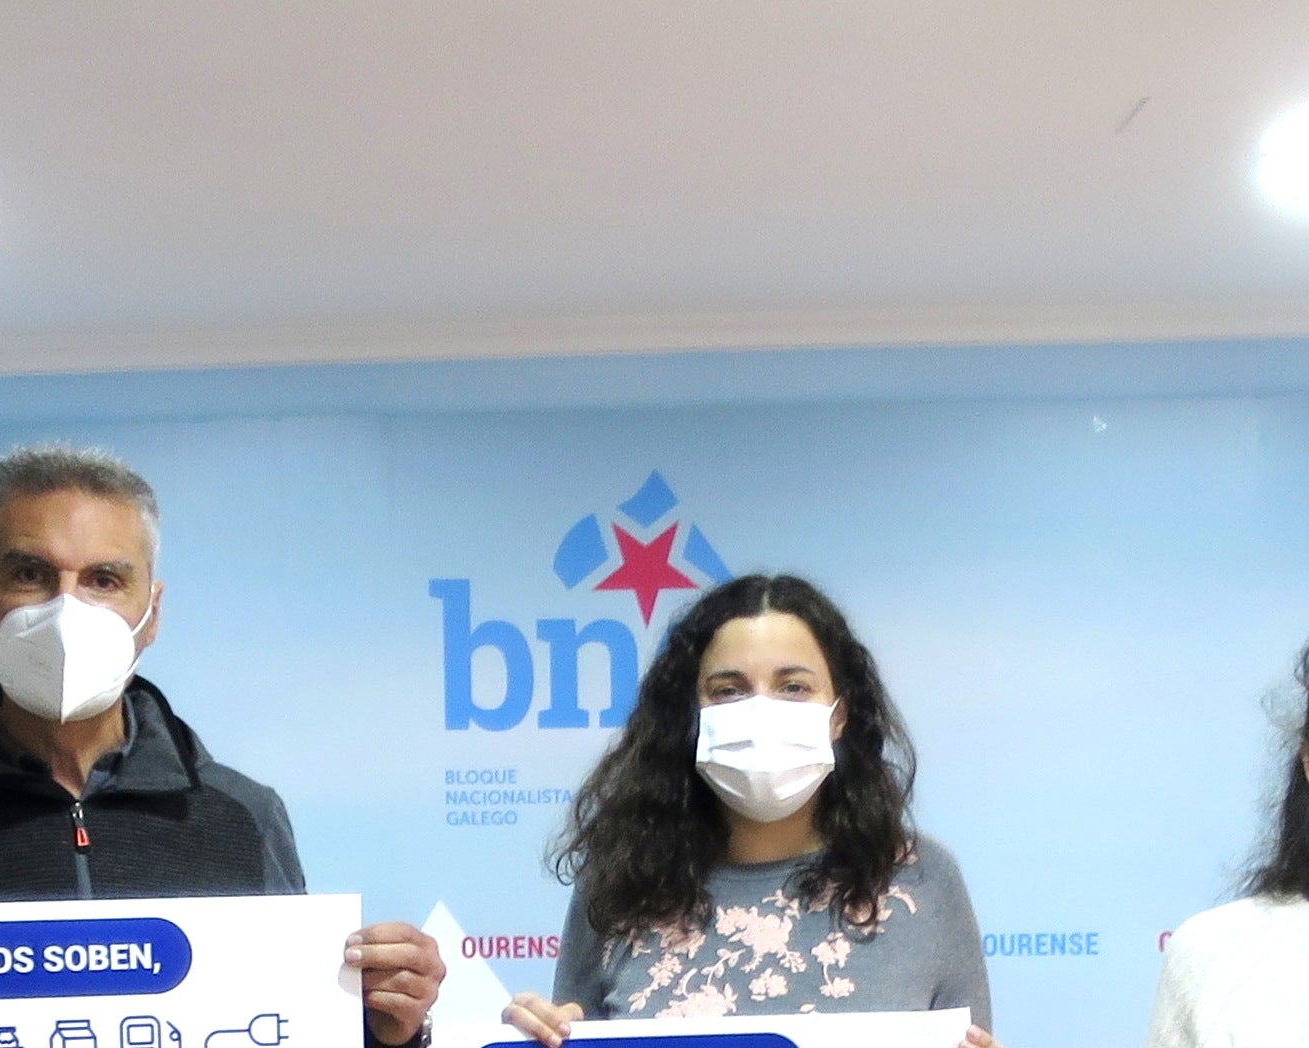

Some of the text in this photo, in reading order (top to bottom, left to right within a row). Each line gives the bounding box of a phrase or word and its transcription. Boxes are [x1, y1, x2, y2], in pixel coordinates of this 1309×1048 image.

[428, 578, 640, 732] bn
[444, 769, 518, 785] BLOQUE
[444, 789, 574, 805] NACIONALISTA
[445, 811, 518, 826] GALEGO
[461, 936, 561, 959] OURENS
[981, 932, 1099, 957] OURENSE
[42, 943, 162, 974] SOBEN,
